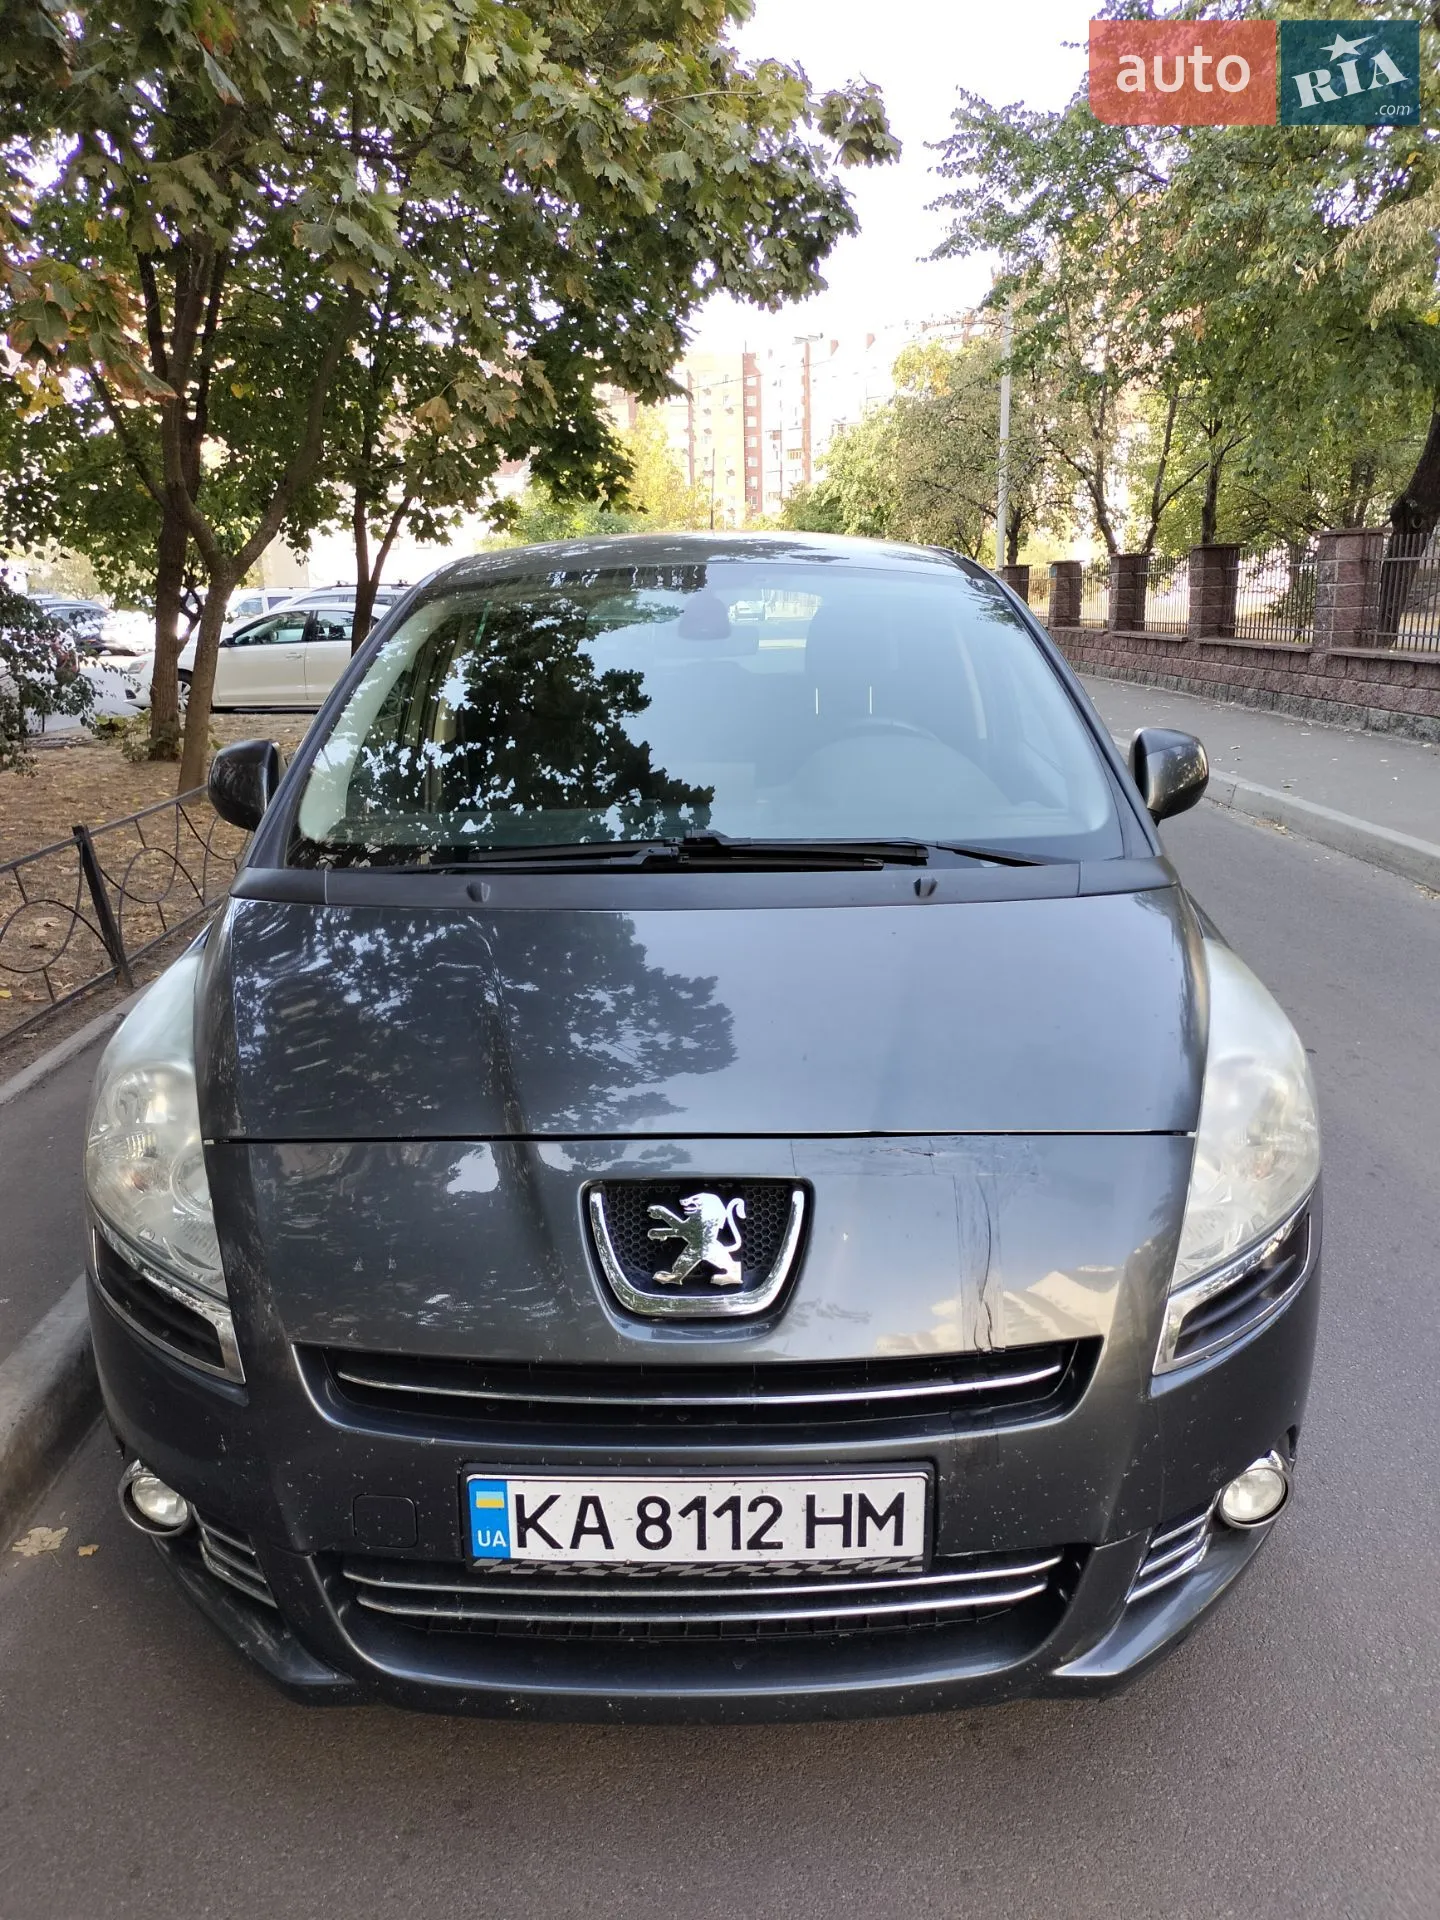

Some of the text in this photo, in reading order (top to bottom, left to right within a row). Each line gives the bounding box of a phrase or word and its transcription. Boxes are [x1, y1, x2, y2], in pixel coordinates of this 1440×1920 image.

[477, 1529, 507, 1547] UA
[515, 1492, 905, 1550] KA 8112 HM
